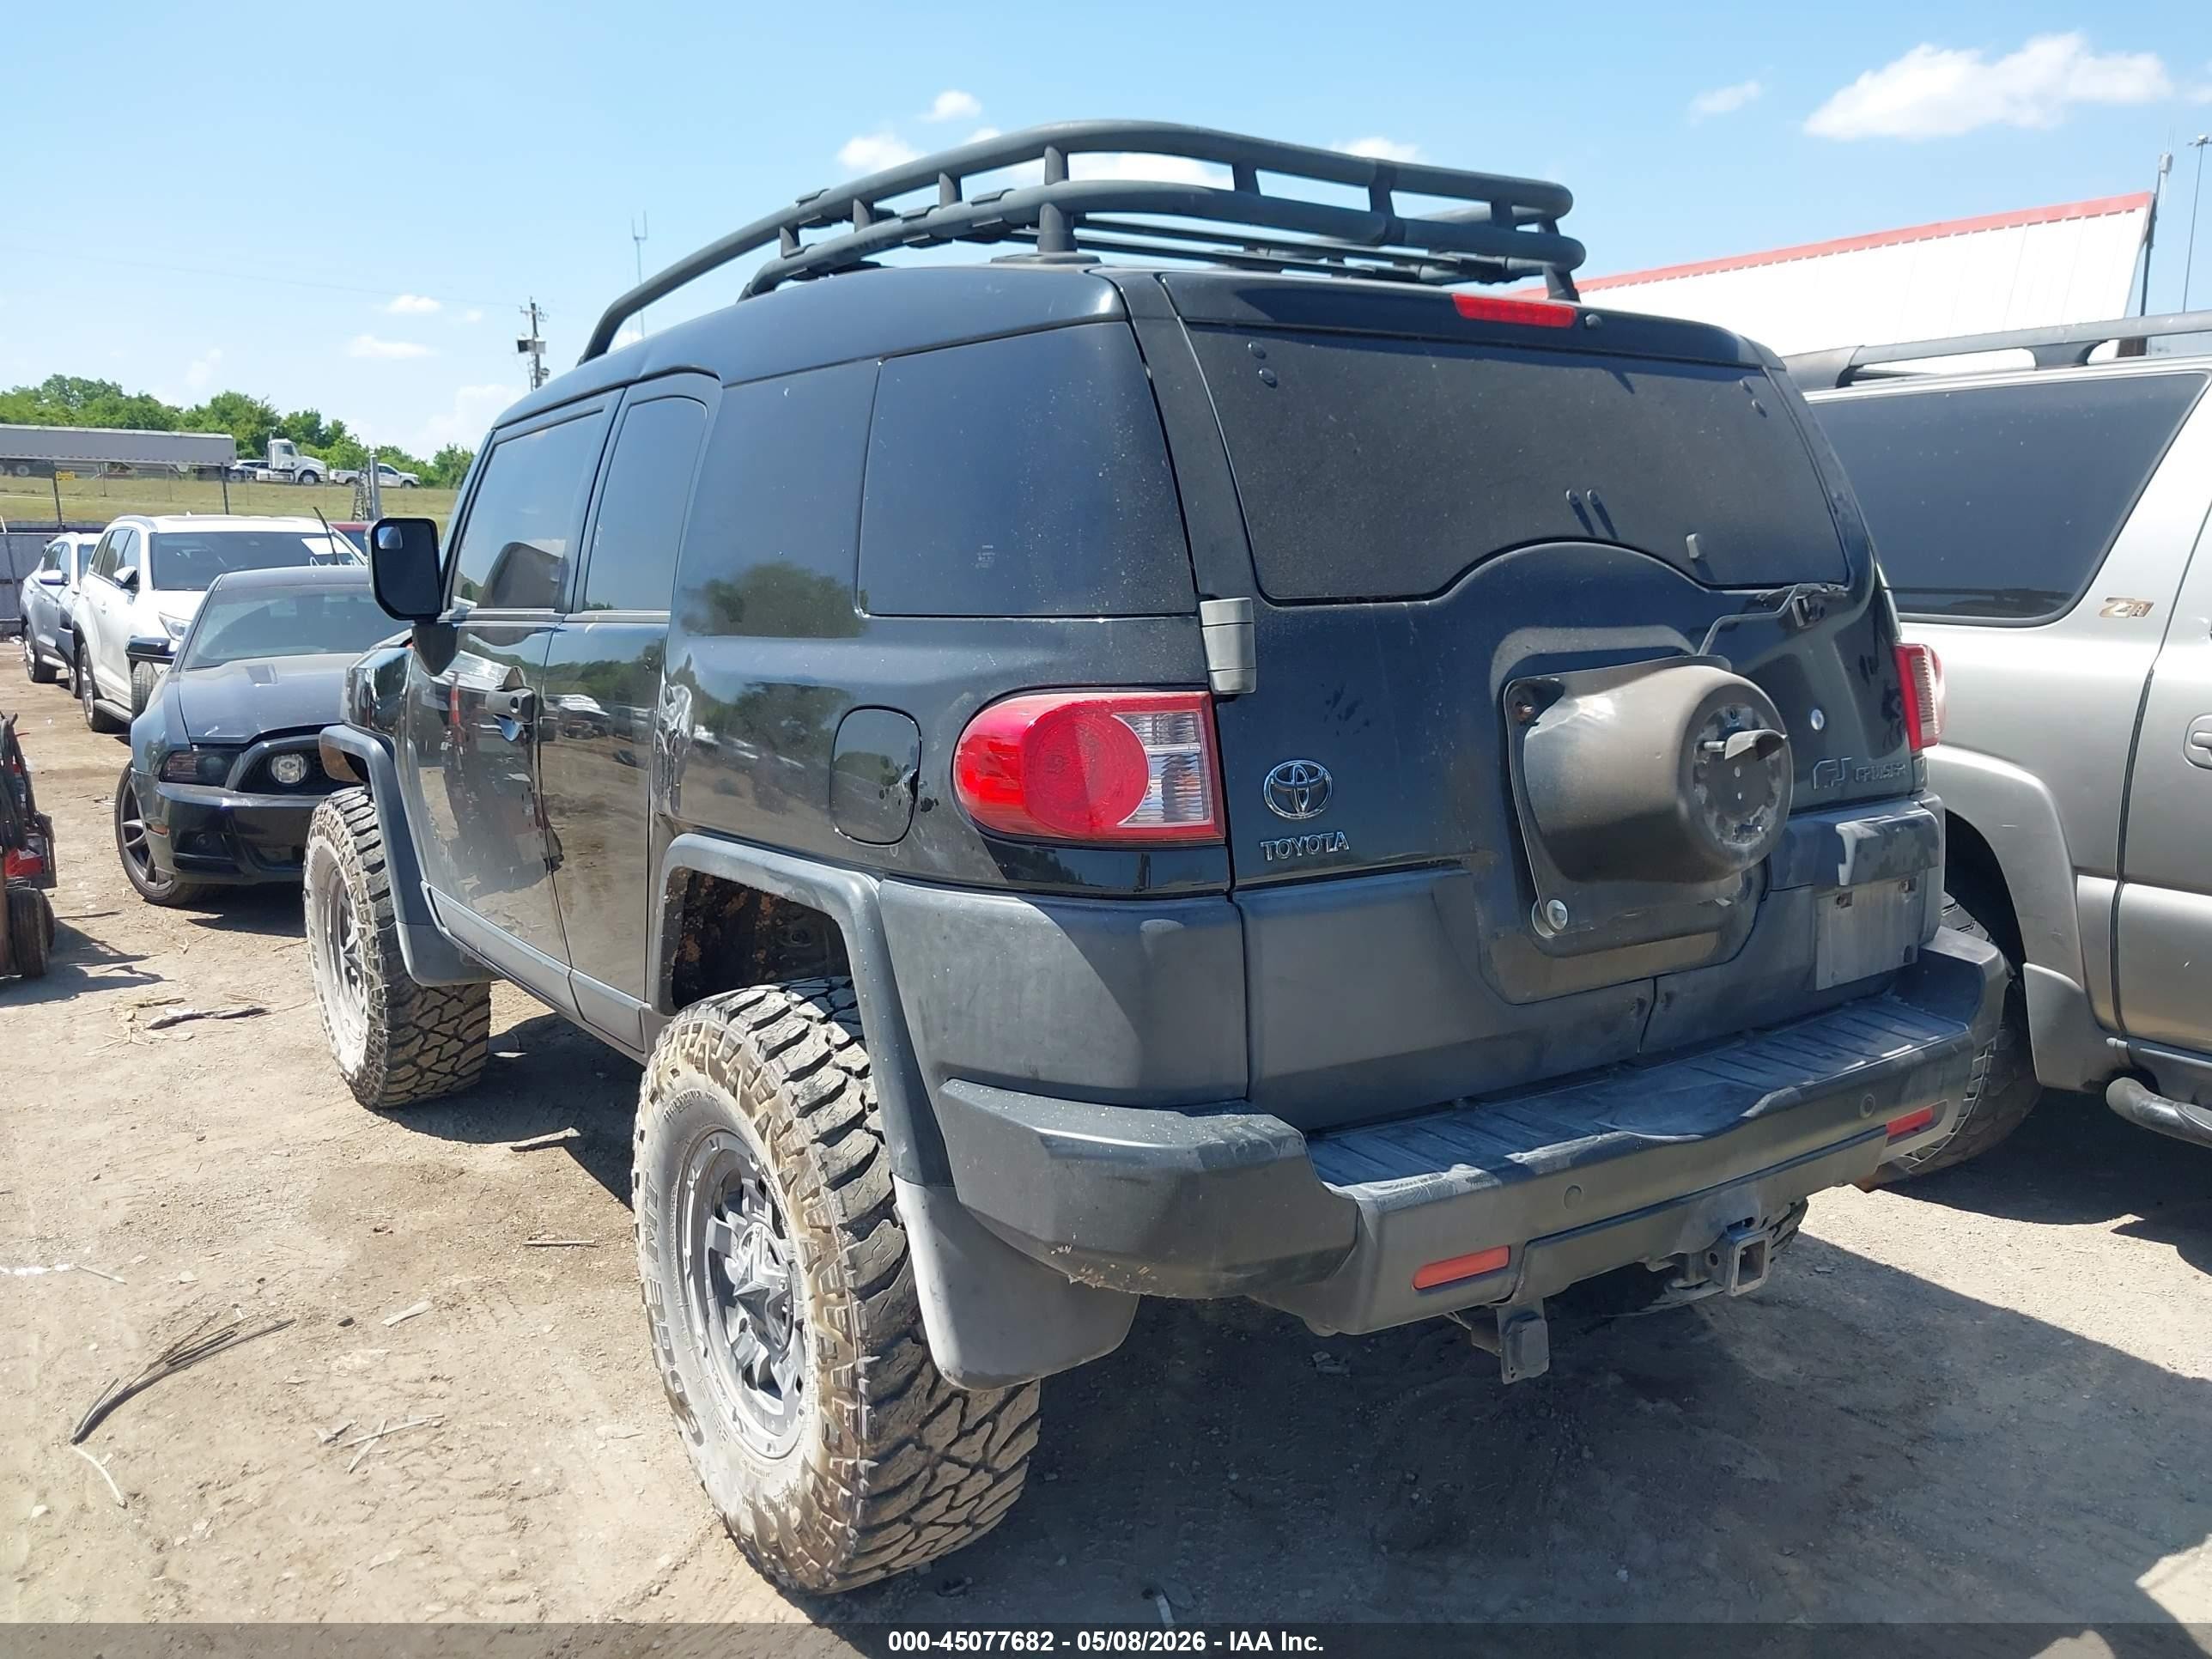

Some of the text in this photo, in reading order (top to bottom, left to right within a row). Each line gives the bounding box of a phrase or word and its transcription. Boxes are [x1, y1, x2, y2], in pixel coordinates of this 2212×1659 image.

[1813, 757, 1852, 790] FJ
[1260, 831, 1350, 861] TOYOTA
[644, 1169, 659, 1264] MT
